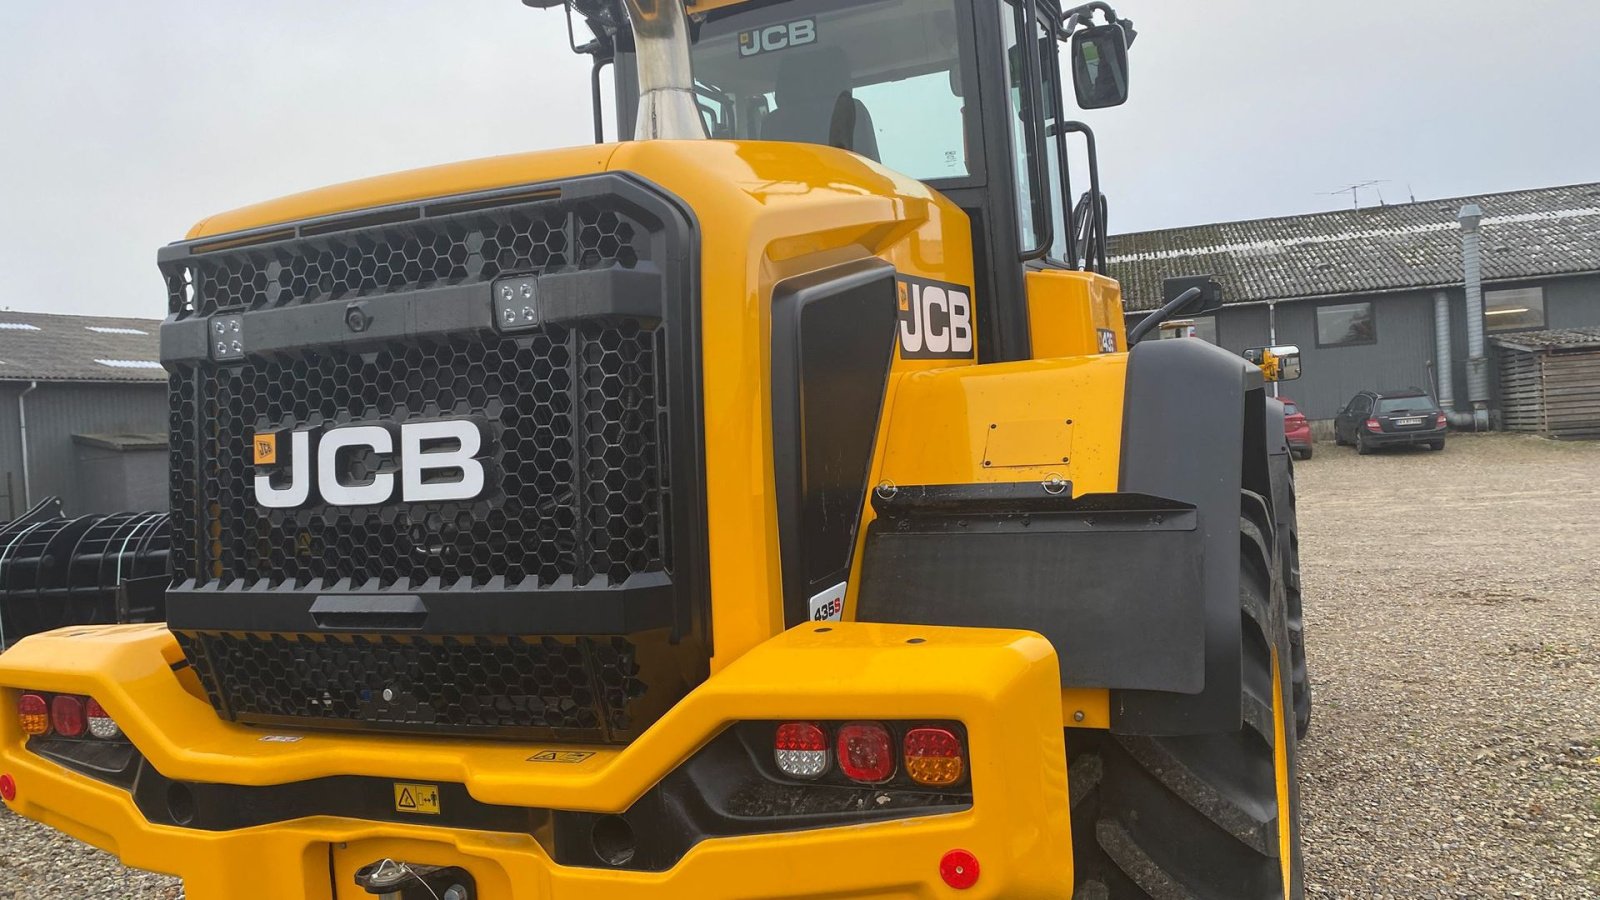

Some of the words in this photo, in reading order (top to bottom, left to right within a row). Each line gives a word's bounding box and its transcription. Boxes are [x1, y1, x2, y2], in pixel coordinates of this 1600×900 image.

[740, 20, 815, 55] JCB
[900, 283, 972, 352] JCB
[254, 420, 484, 507] JCB
[814, 597, 840, 621] 435S
